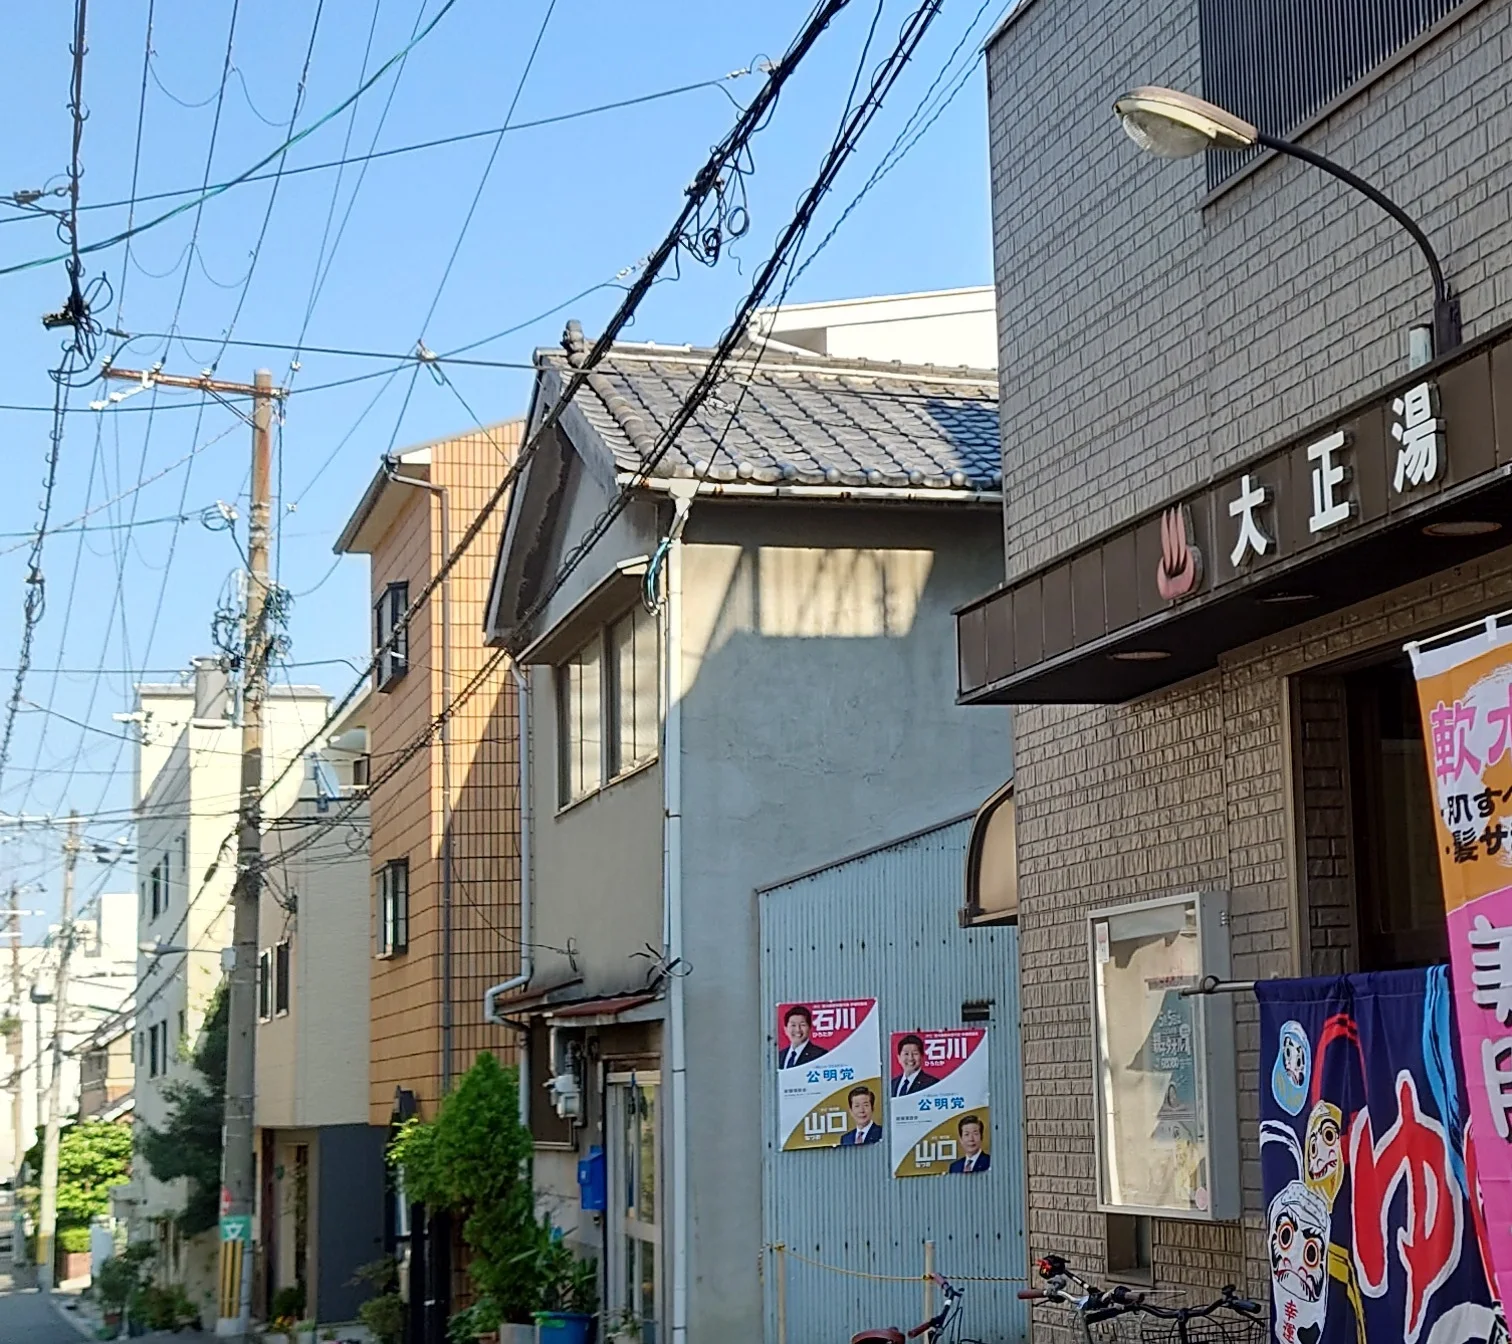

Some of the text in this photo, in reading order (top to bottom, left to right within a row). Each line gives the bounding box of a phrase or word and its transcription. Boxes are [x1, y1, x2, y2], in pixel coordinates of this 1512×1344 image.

[1230, 382, 1438, 567] 大正湯
[812, 1007, 857, 1031] 石川
[924, 1037, 968, 1061] 石川
[806, 1067, 855, 1084] 公明党
[918, 1096, 965, 1112] 公明党
[804, 1111, 848, 1135] 山口
[915, 1139, 957, 1162] 山口
